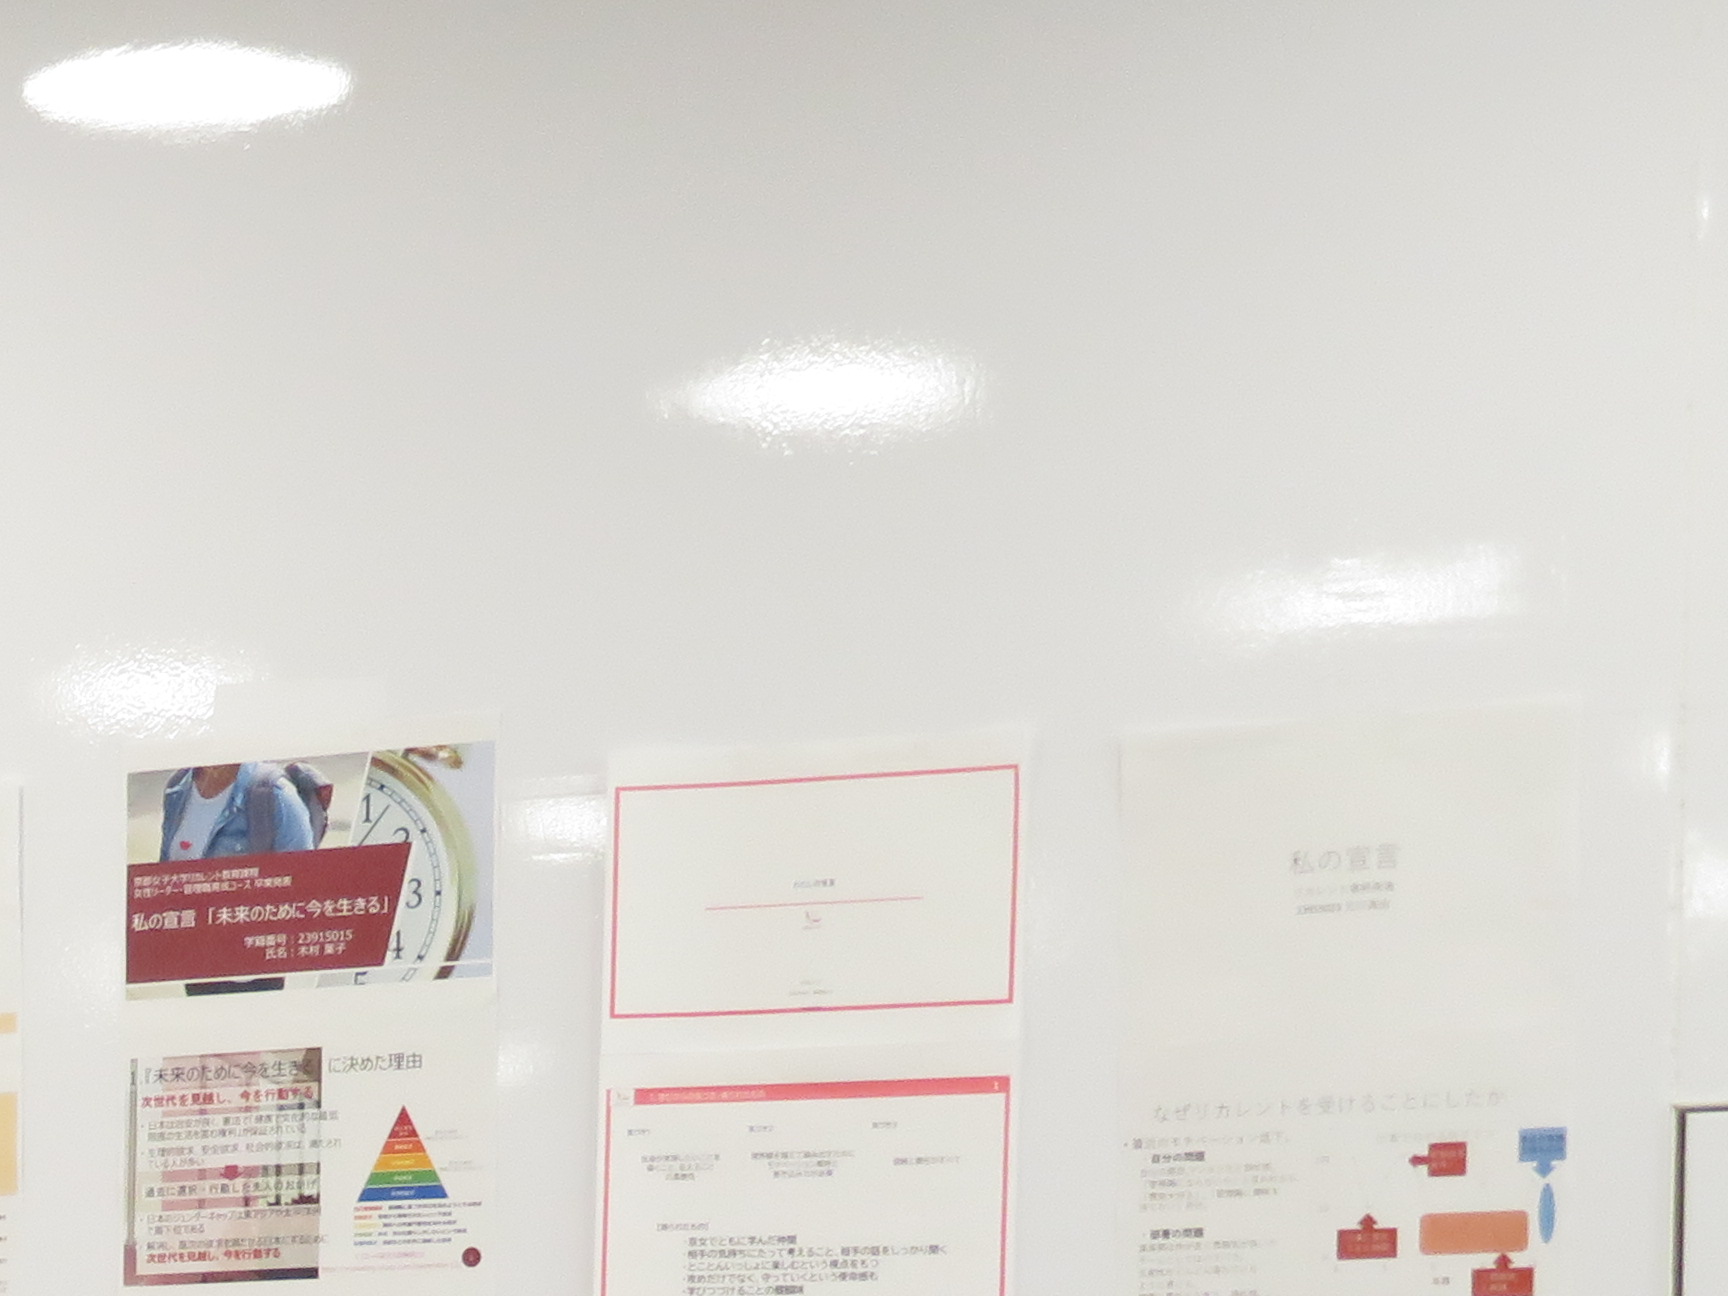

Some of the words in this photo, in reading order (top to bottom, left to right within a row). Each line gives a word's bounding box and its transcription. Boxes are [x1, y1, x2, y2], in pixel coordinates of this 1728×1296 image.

[1289, 843, 1400, 875] 私の宣言
[131, 909, 196, 932] 私の宣言
[206, 896, 391, 926] 「未来のために今を生きる」
[142, 1086, 314, 1109] 次世代を見越し、今を行動する
[1154, 1088, 1507, 1124] なぜリカレントを受けることにしたか
[146, 1247, 282, 1264] 次世代を見越し、今を行動する
